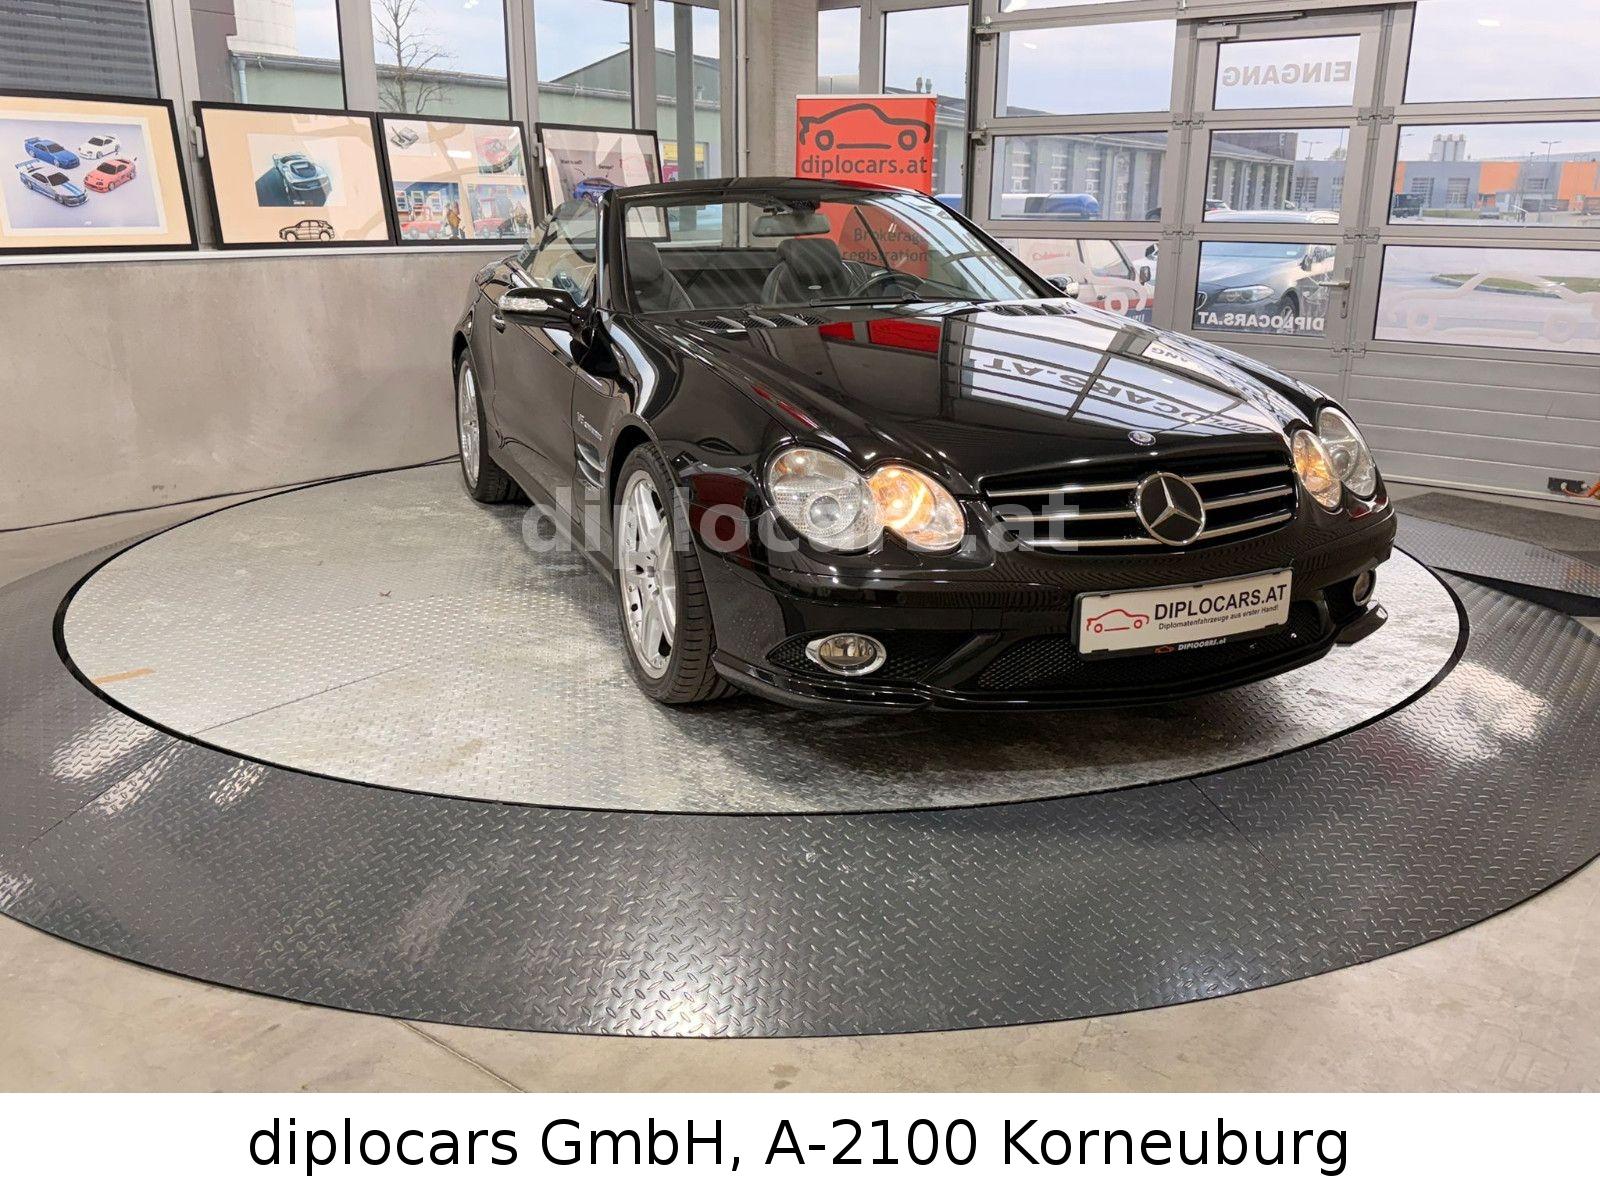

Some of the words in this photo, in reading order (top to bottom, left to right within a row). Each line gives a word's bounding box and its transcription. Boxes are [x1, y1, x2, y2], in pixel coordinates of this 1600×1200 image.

[801, 155, 928, 177] diplocars.at
[842, 248, 928, 262] regisration
[1154, 584, 1287, 620] DIPLOCARS.AT
[1159, 615, 1229, 630] Diplomatenfahrzeuge
[1230, 612, 1242, 620] aus
